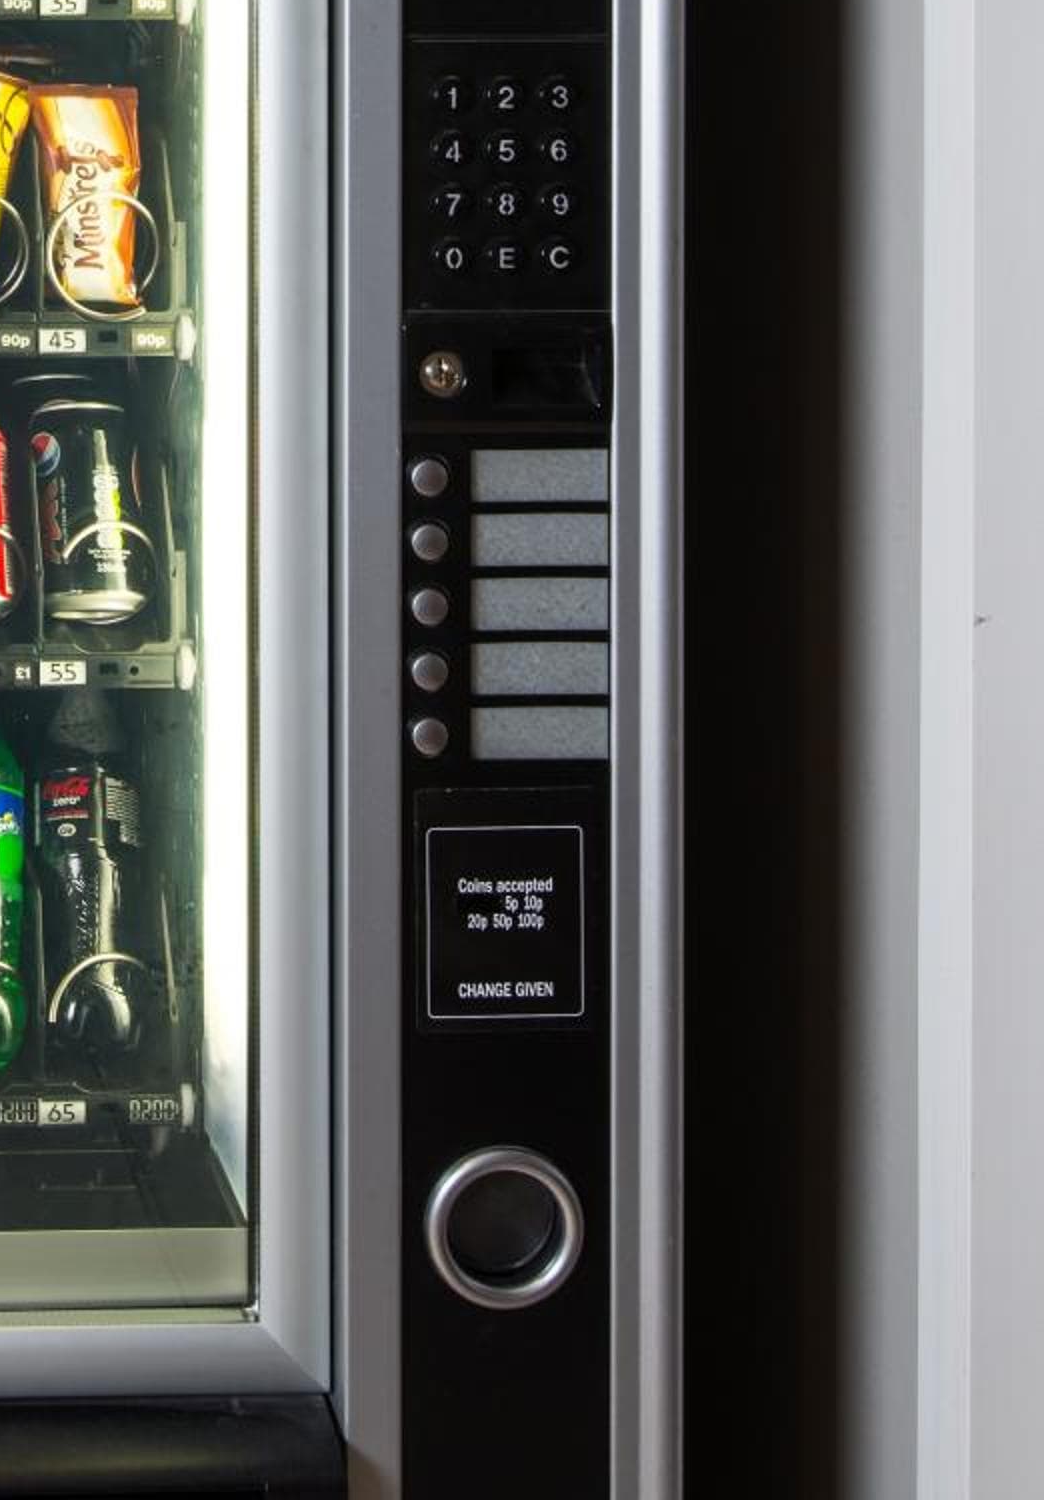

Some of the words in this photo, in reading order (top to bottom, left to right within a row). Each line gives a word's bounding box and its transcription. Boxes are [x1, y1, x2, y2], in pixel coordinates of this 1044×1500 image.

[448, 87, 458, 110] 1
[498, 86, 515, 109] 2
[552, 85, 569, 108] 3
[445, 140, 461, 162] 4
[499, 139, 515, 162] 5
[550, 139, 567, 162] 6
[73, 140, 105, 270] Minstrels
[445, 193, 461, 216] 7
[499, 193, 515, 215] 8
[553, 193, 569, 215] 9
[445, 247, 463, 269] 0
[499, 248, 515, 269] E
[549, 246, 570, 269] C
[1, 333, 30, 348] 90p
[49, 332, 77, 350] 45
[50, 662, 77, 681] 55
[458, 877, 493, 894] Coins
[496, 876, 554, 895] accepted
[505, 895, 519, 913] 5p
[523, 895, 544, 912] 10p
[467, 913, 488, 931] 20p
[493, 913, 513, 931] 50p
[517, 912, 545, 931] 100p
[458, 981, 512, 999] CHANGE
[515, 981, 554, 998] GIVEN
[47, 1102, 76, 1122] 65
